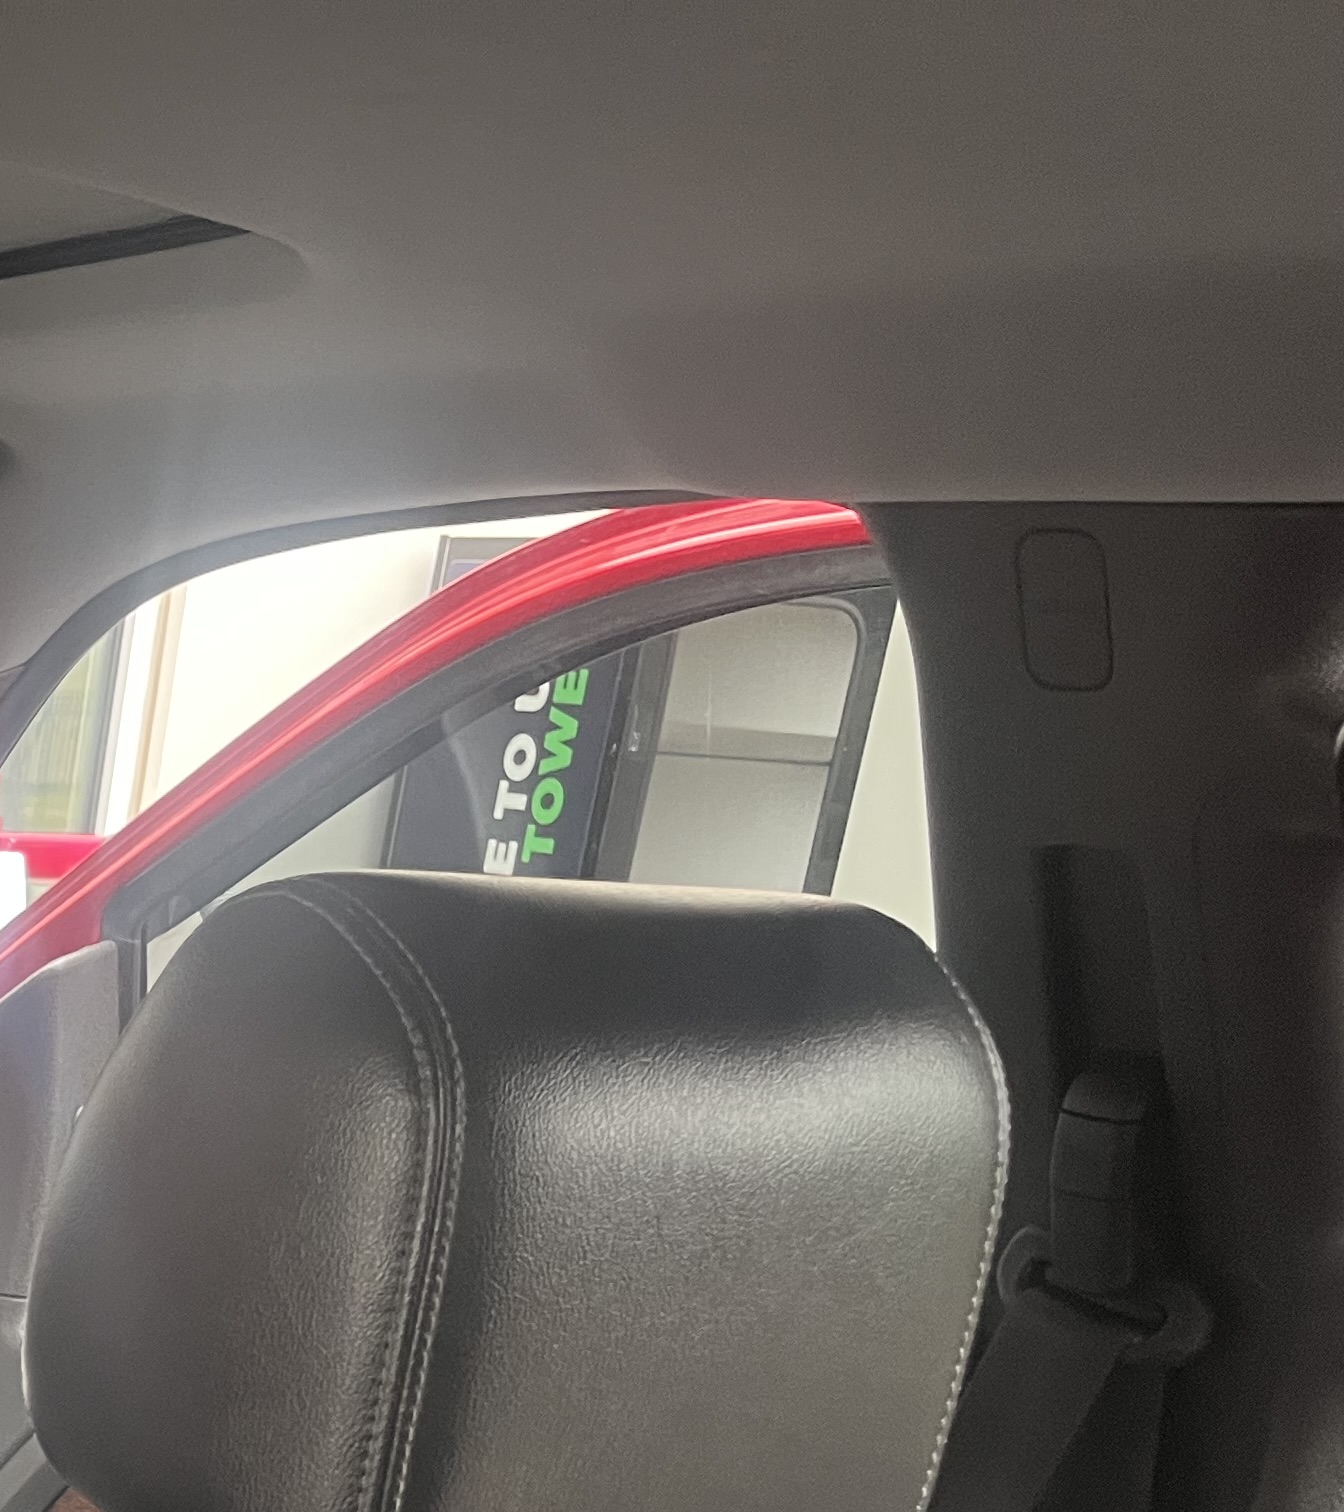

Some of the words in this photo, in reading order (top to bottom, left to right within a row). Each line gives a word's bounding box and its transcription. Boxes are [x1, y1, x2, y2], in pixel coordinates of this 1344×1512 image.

[493, 732, 537, 821] TO
[520, 668, 590, 864] TOWE
[483, 838, 518, 875] E
